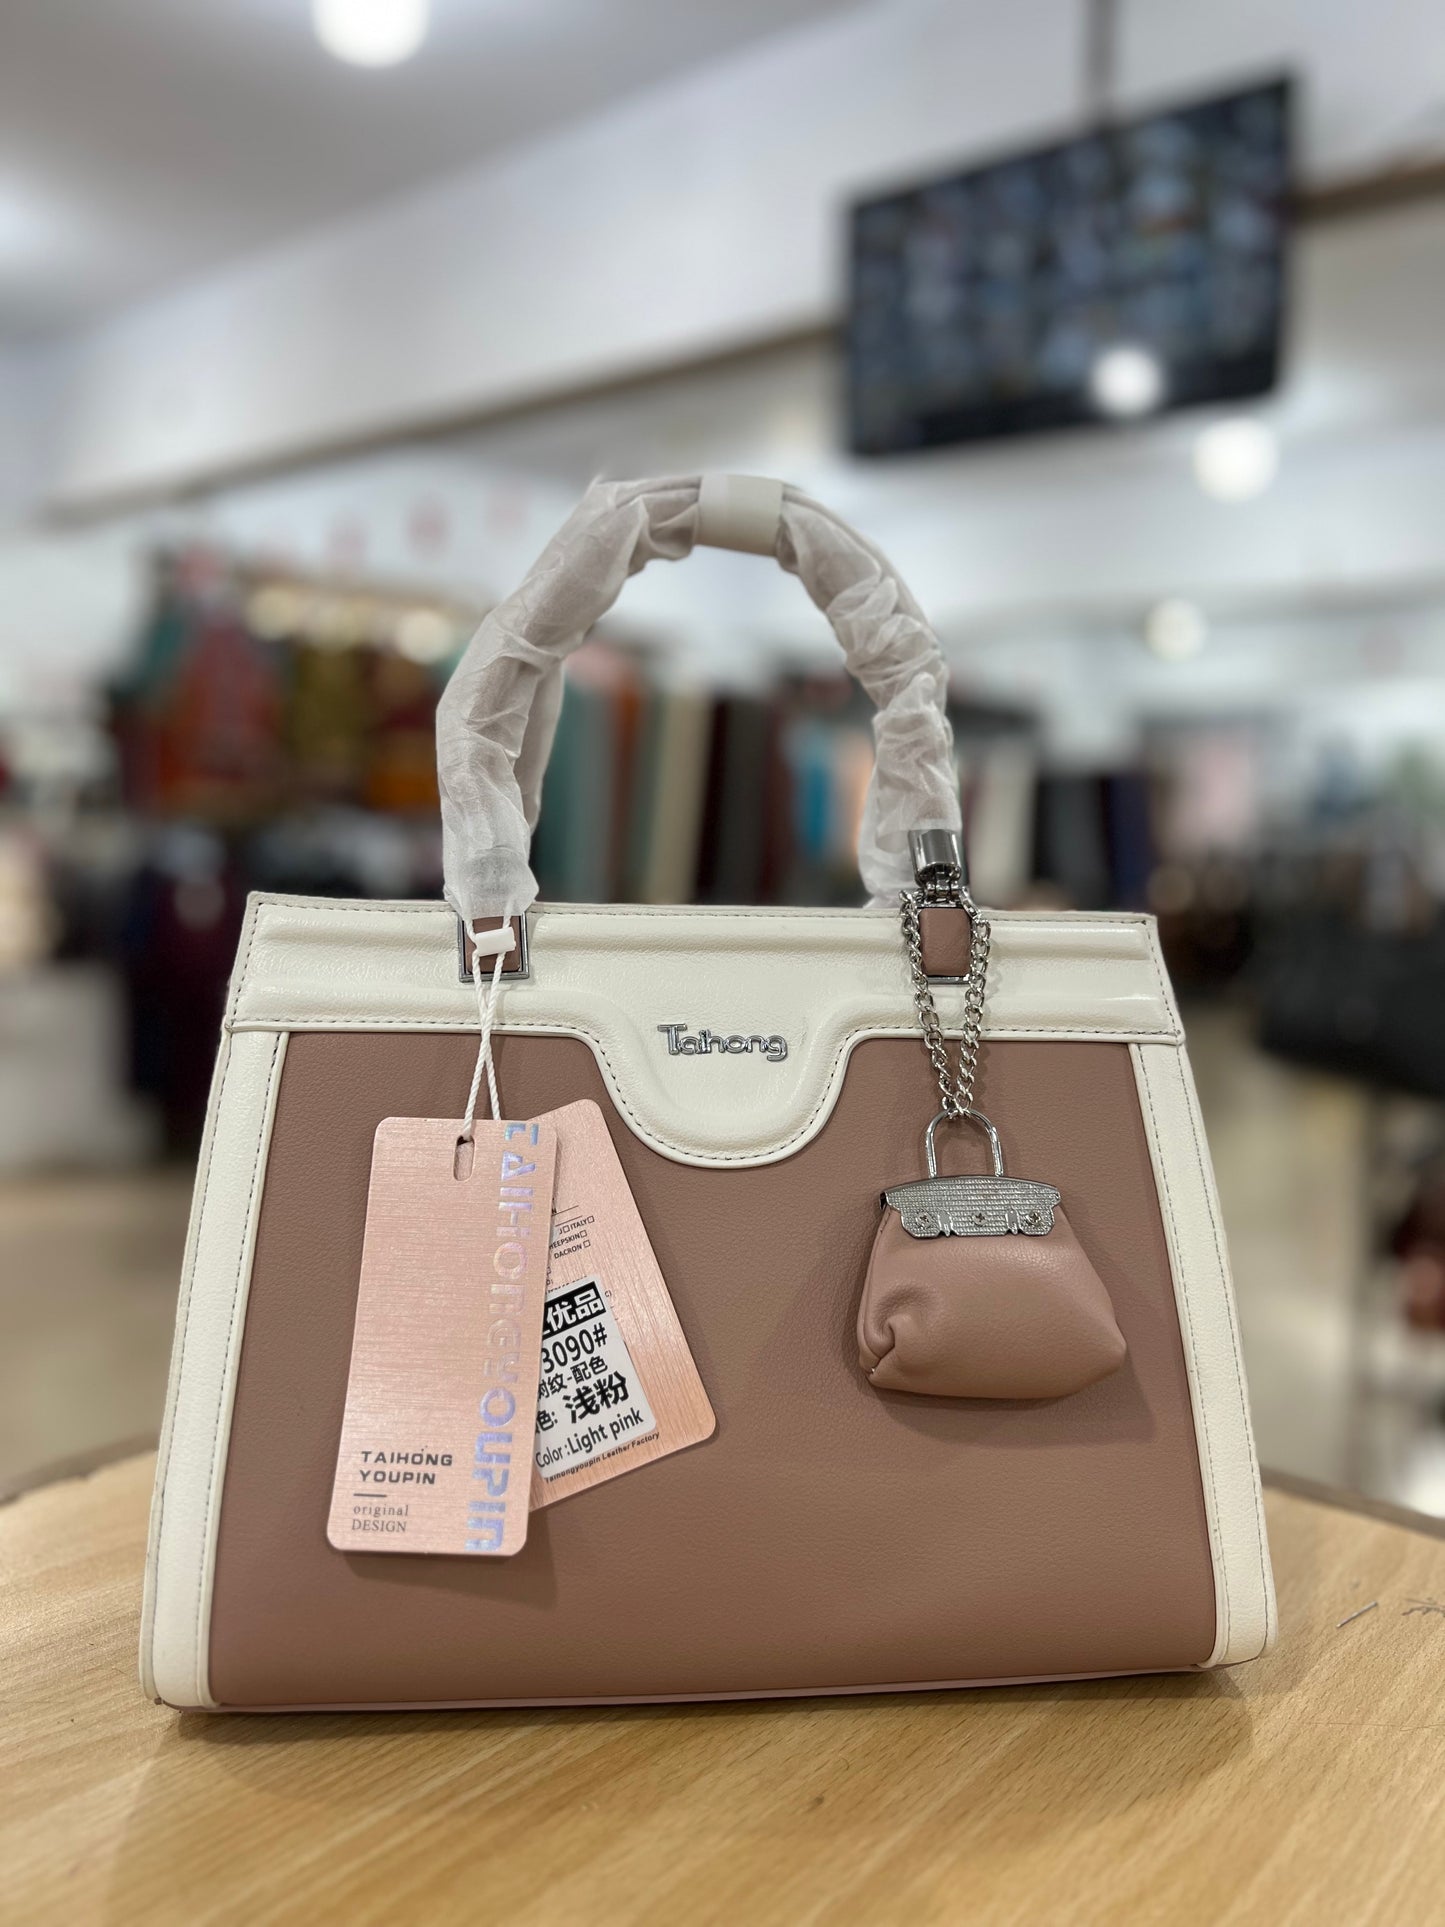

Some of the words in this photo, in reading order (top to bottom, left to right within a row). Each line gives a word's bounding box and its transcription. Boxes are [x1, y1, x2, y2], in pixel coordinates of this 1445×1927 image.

[657, 1023, 788, 1062] Taihong
[570, 1219, 588, 1230] ITALY
[553, 1244, 583, 1259] DACRON
[543, 1288, 604, 1336] 优品
[562, 1371, 629, 1424] 浅粉
[609, 1407, 644, 1440] pink
[601, 1444, 630, 1460] Leather
[632, 1432, 660, 1448] Factory
[361, 1451, 453, 1466] TAIHONG
[360, 1469, 436, 1485] YOUPIN
[353, 1504, 409, 1518] original
[351, 1519, 407, 1533] DESIGN
